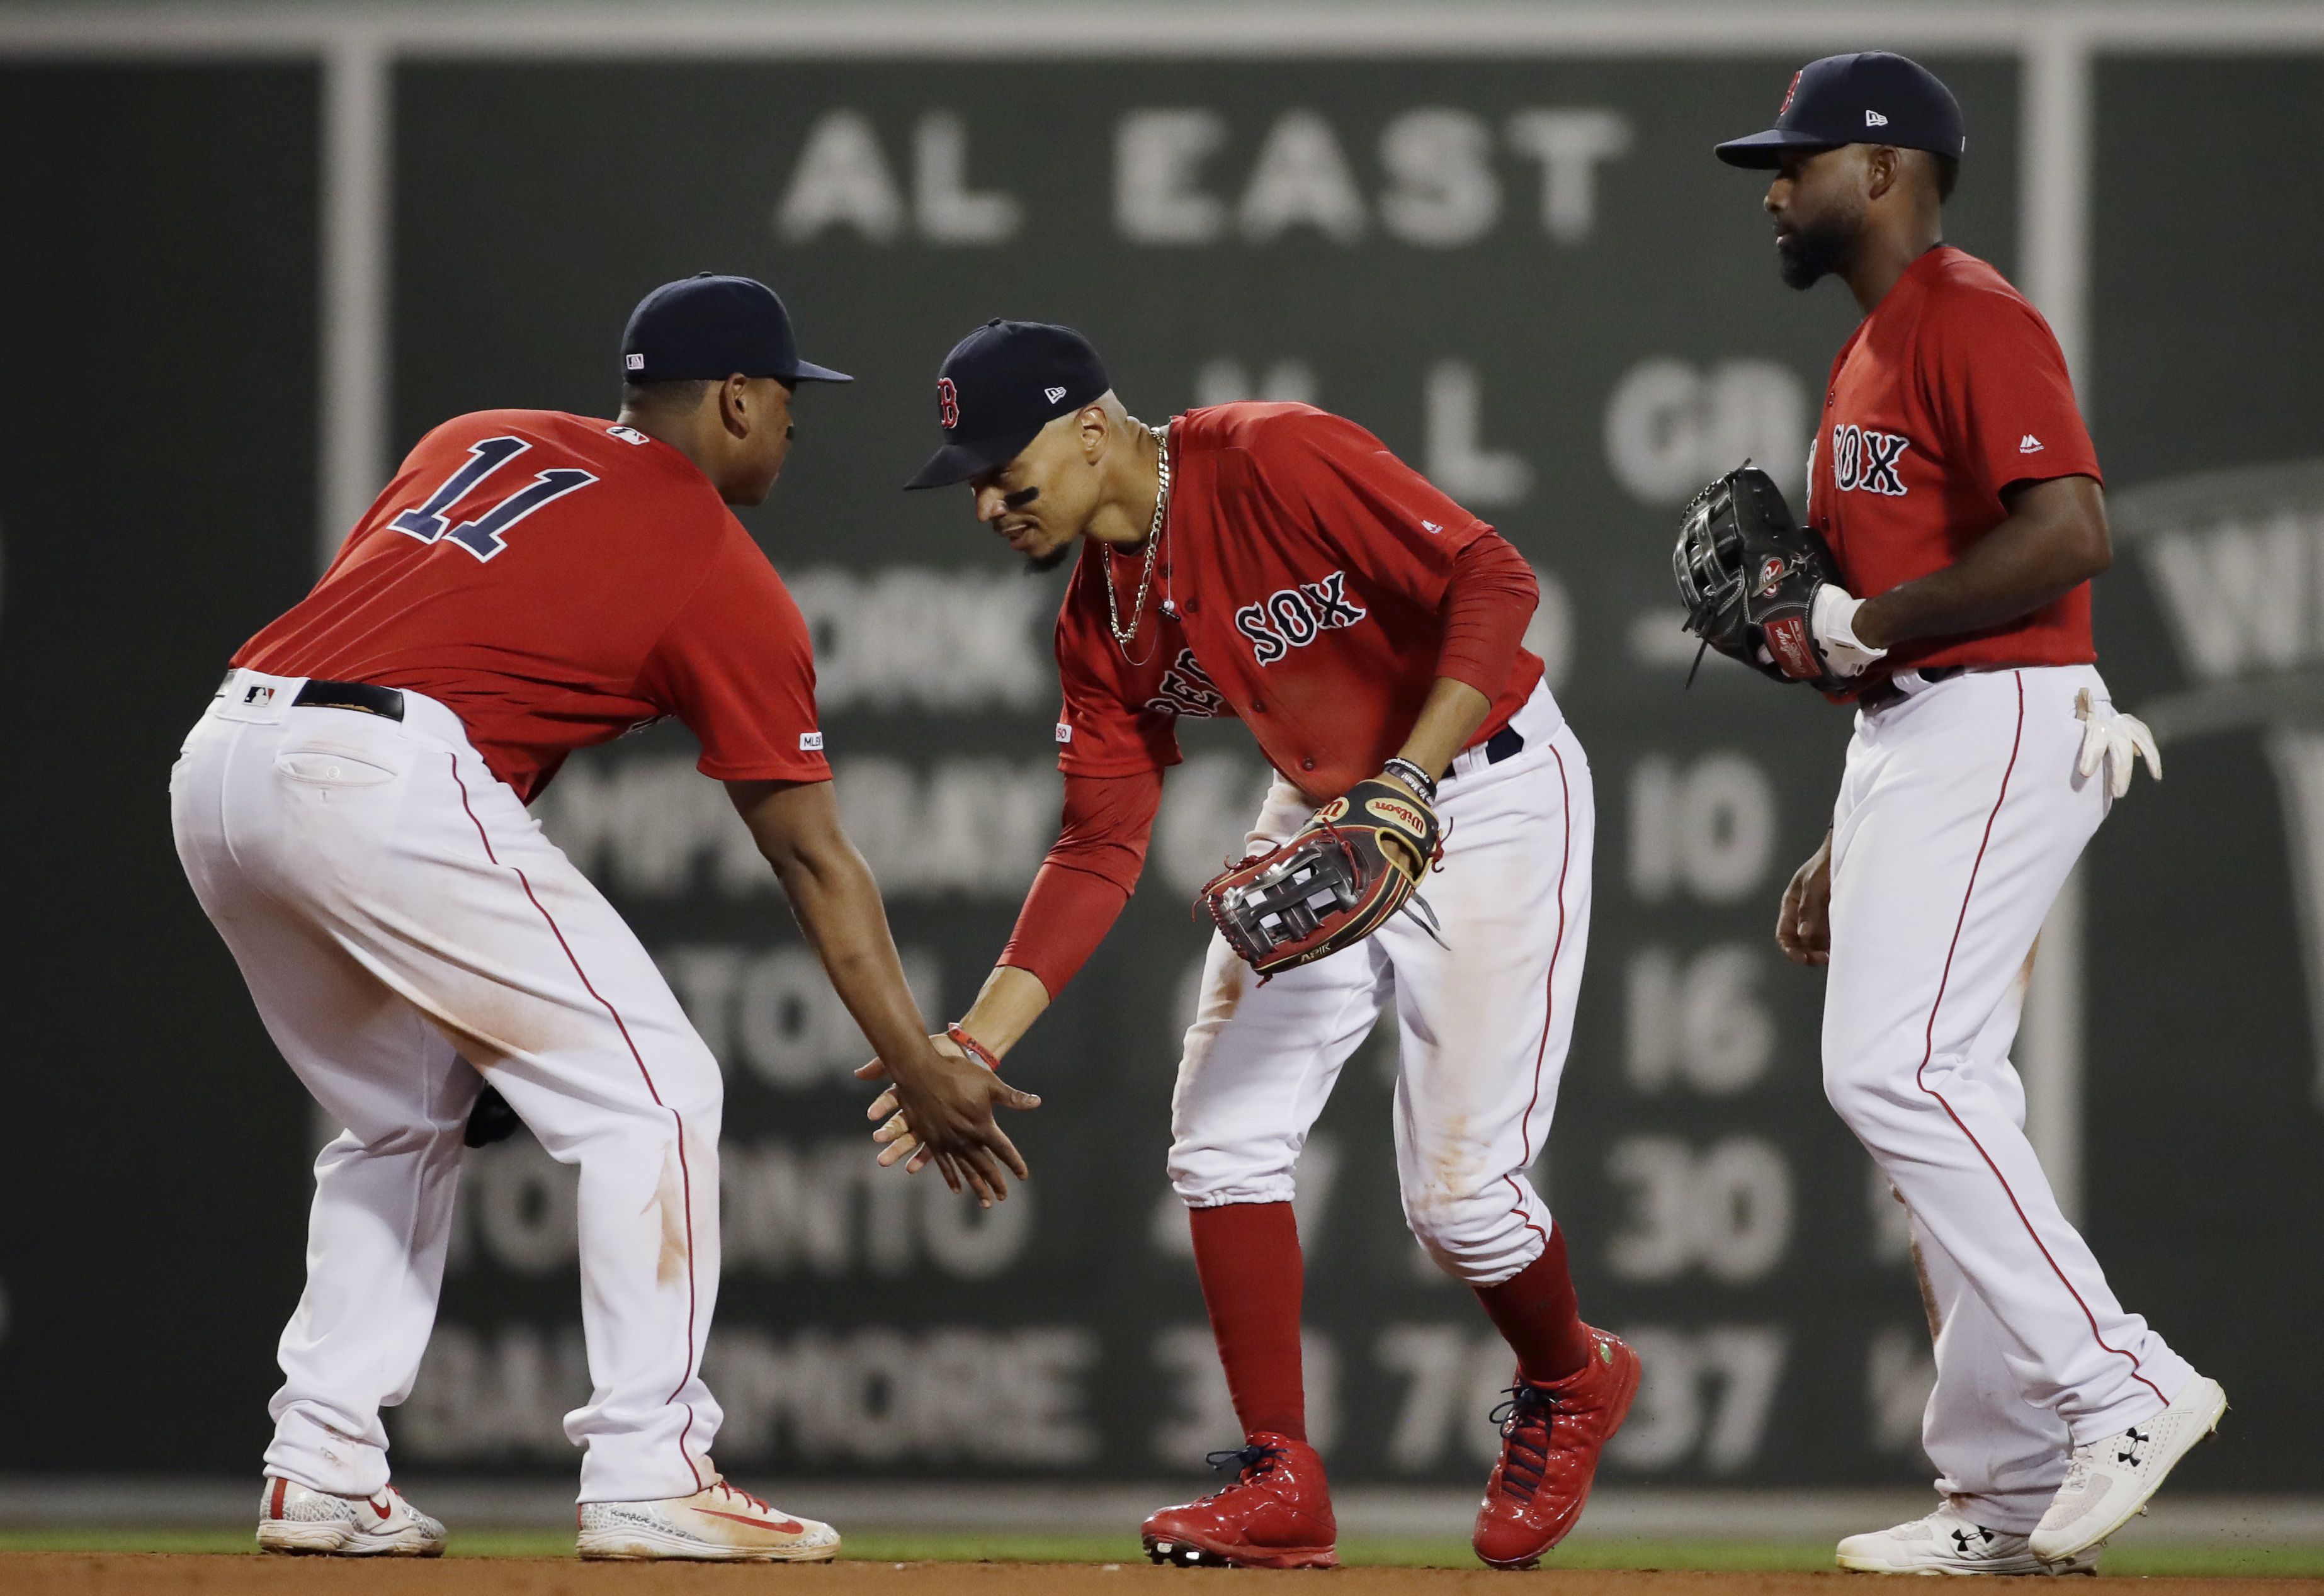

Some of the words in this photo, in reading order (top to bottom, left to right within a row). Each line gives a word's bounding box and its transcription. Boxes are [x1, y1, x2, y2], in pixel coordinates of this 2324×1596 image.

[775, 105, 1024, 246] AL
[1112, 105, 1638, 248] EAST
[937, 378, 960, 429] B
[386, 436, 600, 563] 11
[1235, 570, 1366, 667] SOX
[1375, 801, 1424, 835] Wilson
[1627, 752, 1776, 902] 10
[1624, 944, 1776, 1095] 16
[1601, 1135, 1798, 1284] 30
[1604, 1325, 1789, 1469] 37
